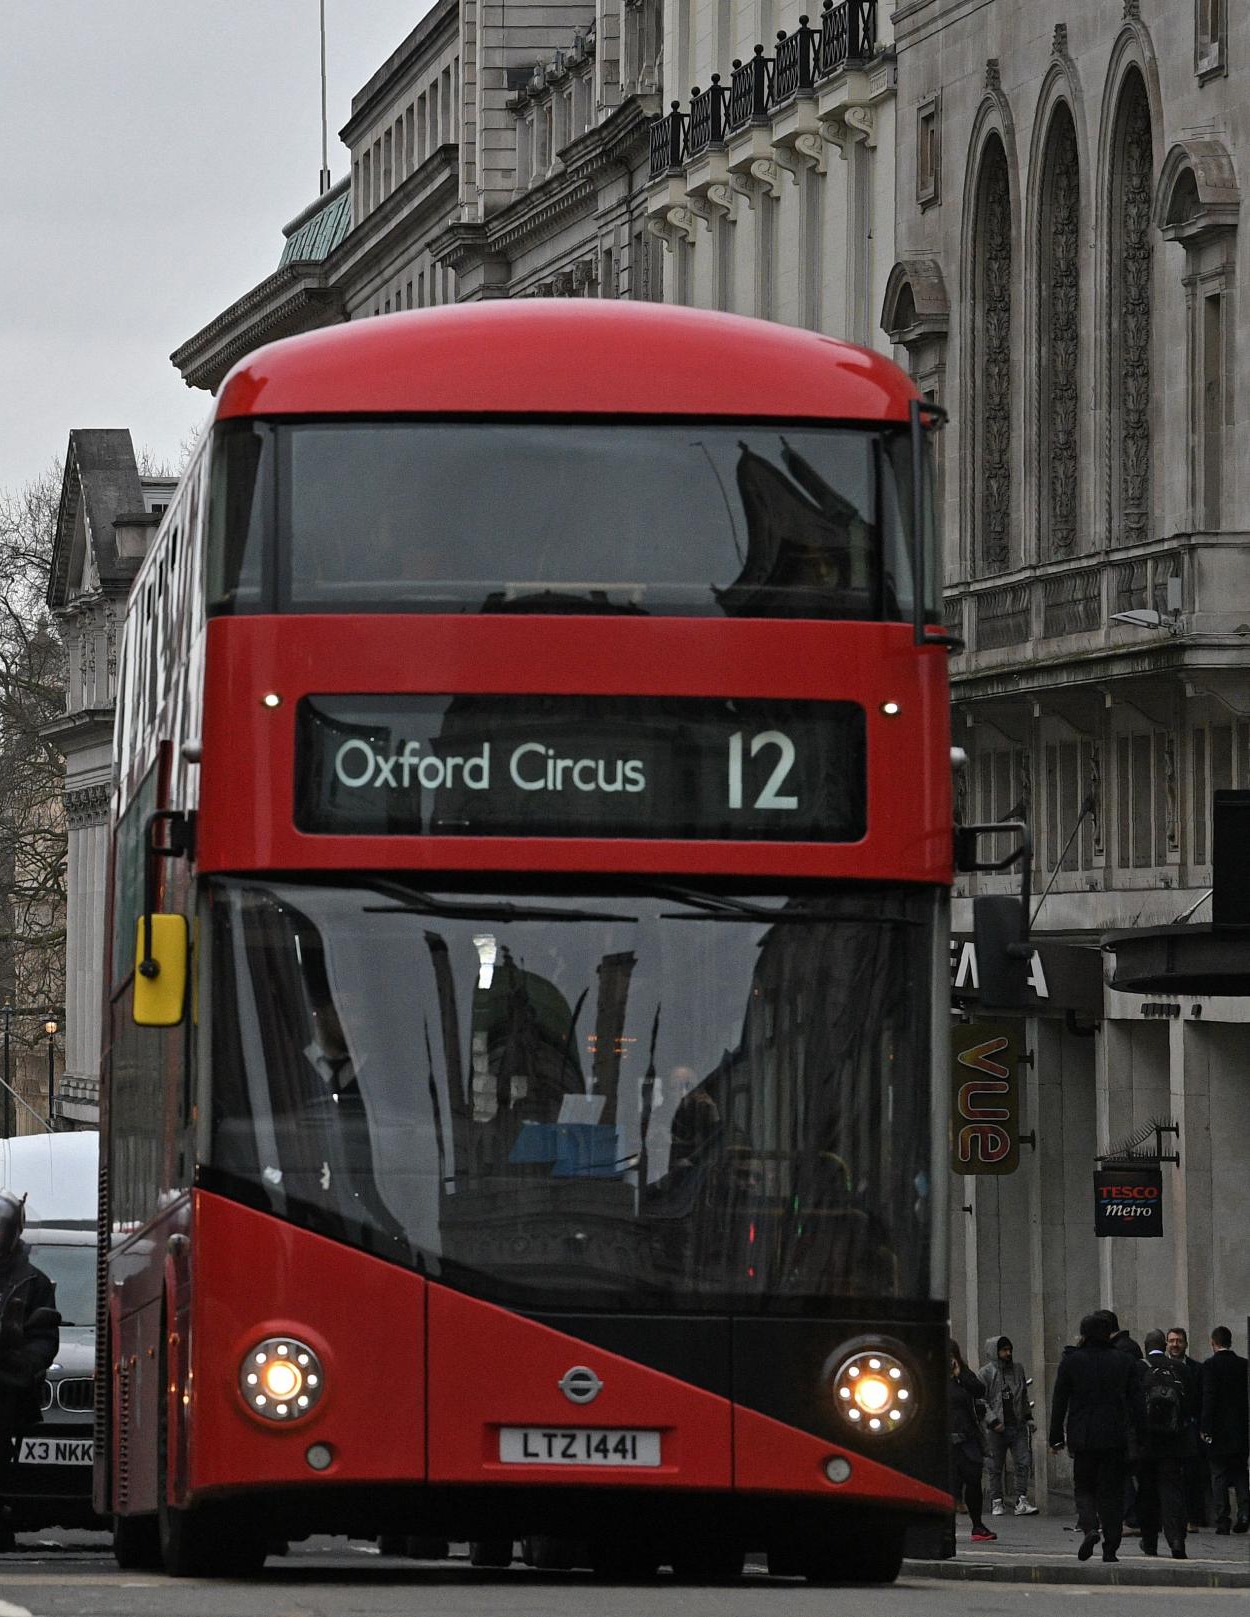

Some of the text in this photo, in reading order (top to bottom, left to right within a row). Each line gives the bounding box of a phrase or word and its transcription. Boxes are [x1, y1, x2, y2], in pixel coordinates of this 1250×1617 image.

[335, 739, 646, 792] Oxford Circus
[728, 730, 798, 809] 12
[1100, 1186, 1159, 1198] TESCO
[1105, 1204, 1152, 1217] Metro
[25, 1442, 93, 1462] X3 NKK
[523, 1433, 637, 1460] LTZ 1441
